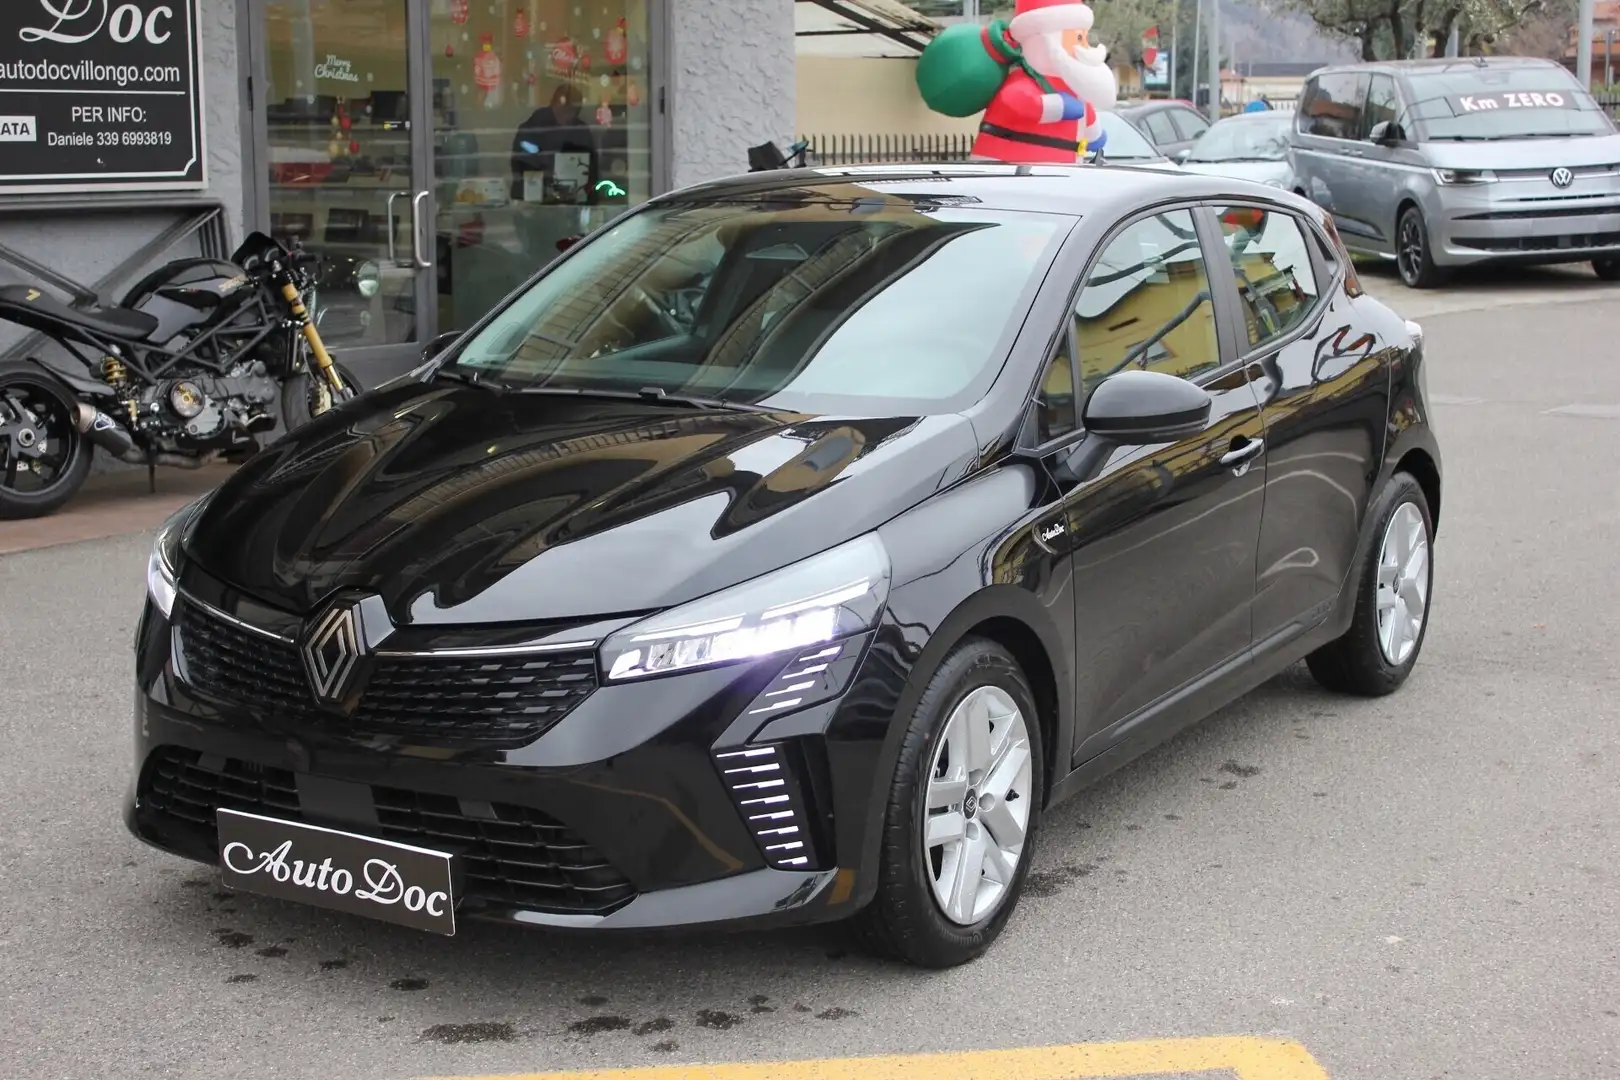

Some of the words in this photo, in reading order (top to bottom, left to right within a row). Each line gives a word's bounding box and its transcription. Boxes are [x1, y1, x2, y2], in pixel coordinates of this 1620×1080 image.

[19, 0, 173, 44] Doc
[1460, 95, 1499, 112] Km
[1503, 92, 1565, 108] ZERO
[71, 106, 104, 123] PER
[107, 107, 147, 123] INFO:
[47, 132, 94, 146] Daniele
[96, 132, 119, 146] 339
[122, 131, 172, 145] 6993819
